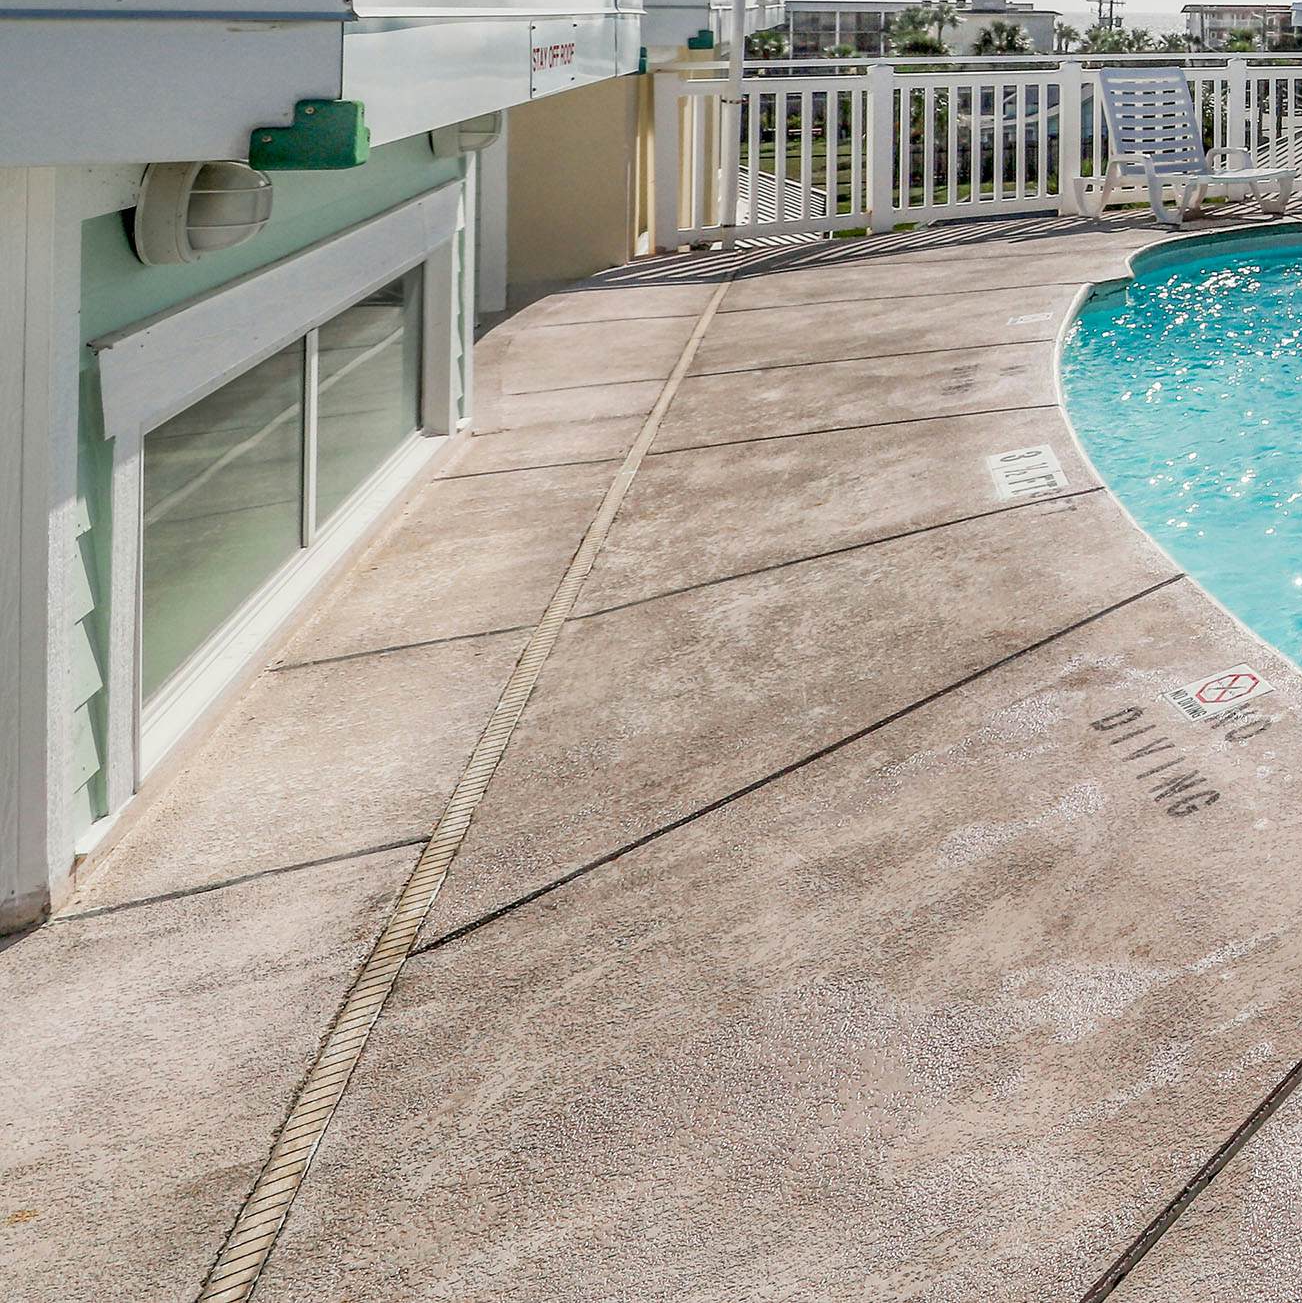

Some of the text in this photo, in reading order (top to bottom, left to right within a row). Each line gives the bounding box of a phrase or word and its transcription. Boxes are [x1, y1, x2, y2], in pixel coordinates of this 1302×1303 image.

[533, 42, 576, 72] STAY OFF ROOF
[1089, 706, 1221, 818] DIVING
